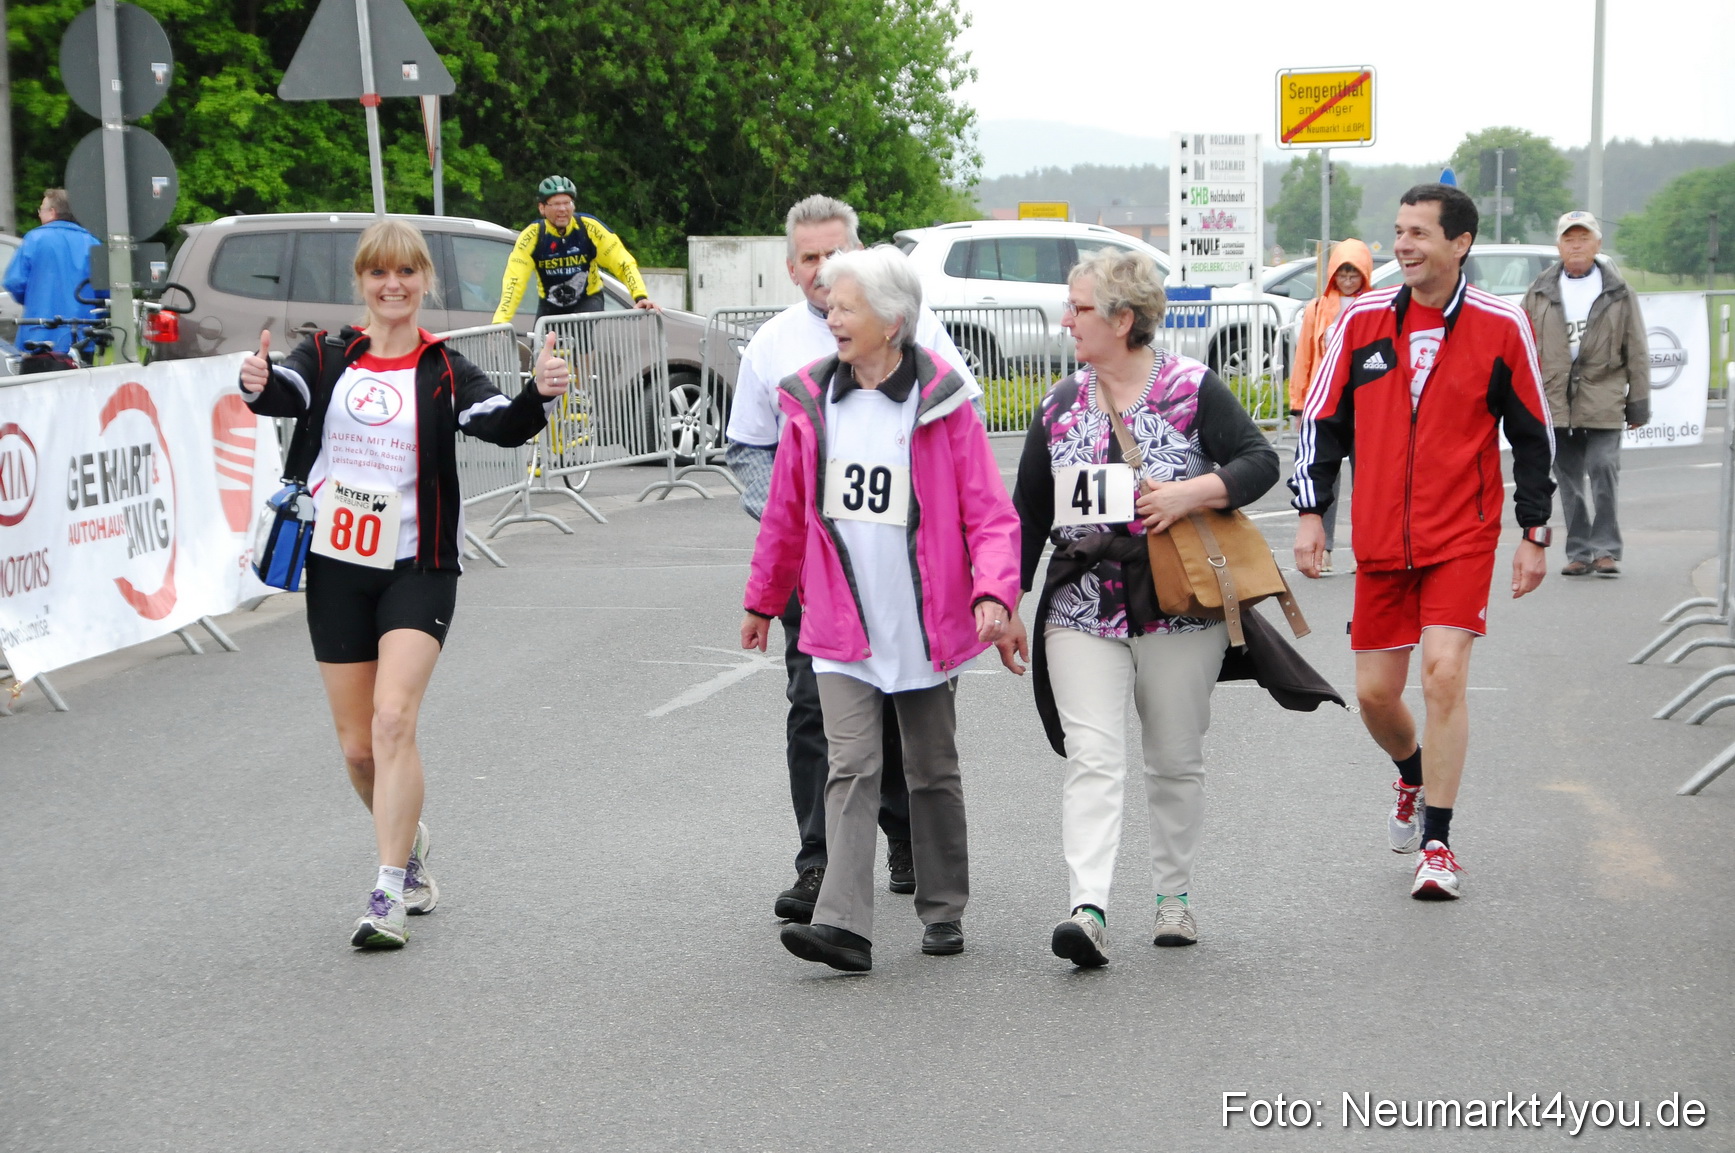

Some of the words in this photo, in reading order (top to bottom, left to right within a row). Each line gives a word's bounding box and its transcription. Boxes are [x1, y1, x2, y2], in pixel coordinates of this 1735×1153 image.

[1289, 80, 1364, 102] Sengenthal
[1306, 123, 1340, 134] Neumarkt
[1190, 187, 1209, 204] SHB
[1190, 238, 1220, 256] THULE
[538, 254, 587, 269] FESTINA
[366, 436, 387, 446] MIT
[345, 447, 363, 455] Heck
[369, 449, 380, 457] Dr.
[332, 456, 404, 473] Leistungsdiagnostik
[335, 484, 370, 503] MEYER
[842, 462, 892, 514] 39
[1071, 468, 1108, 516] 41
[334, 493, 370, 510] WERBUNG
[330, 506, 382, 557] 80
